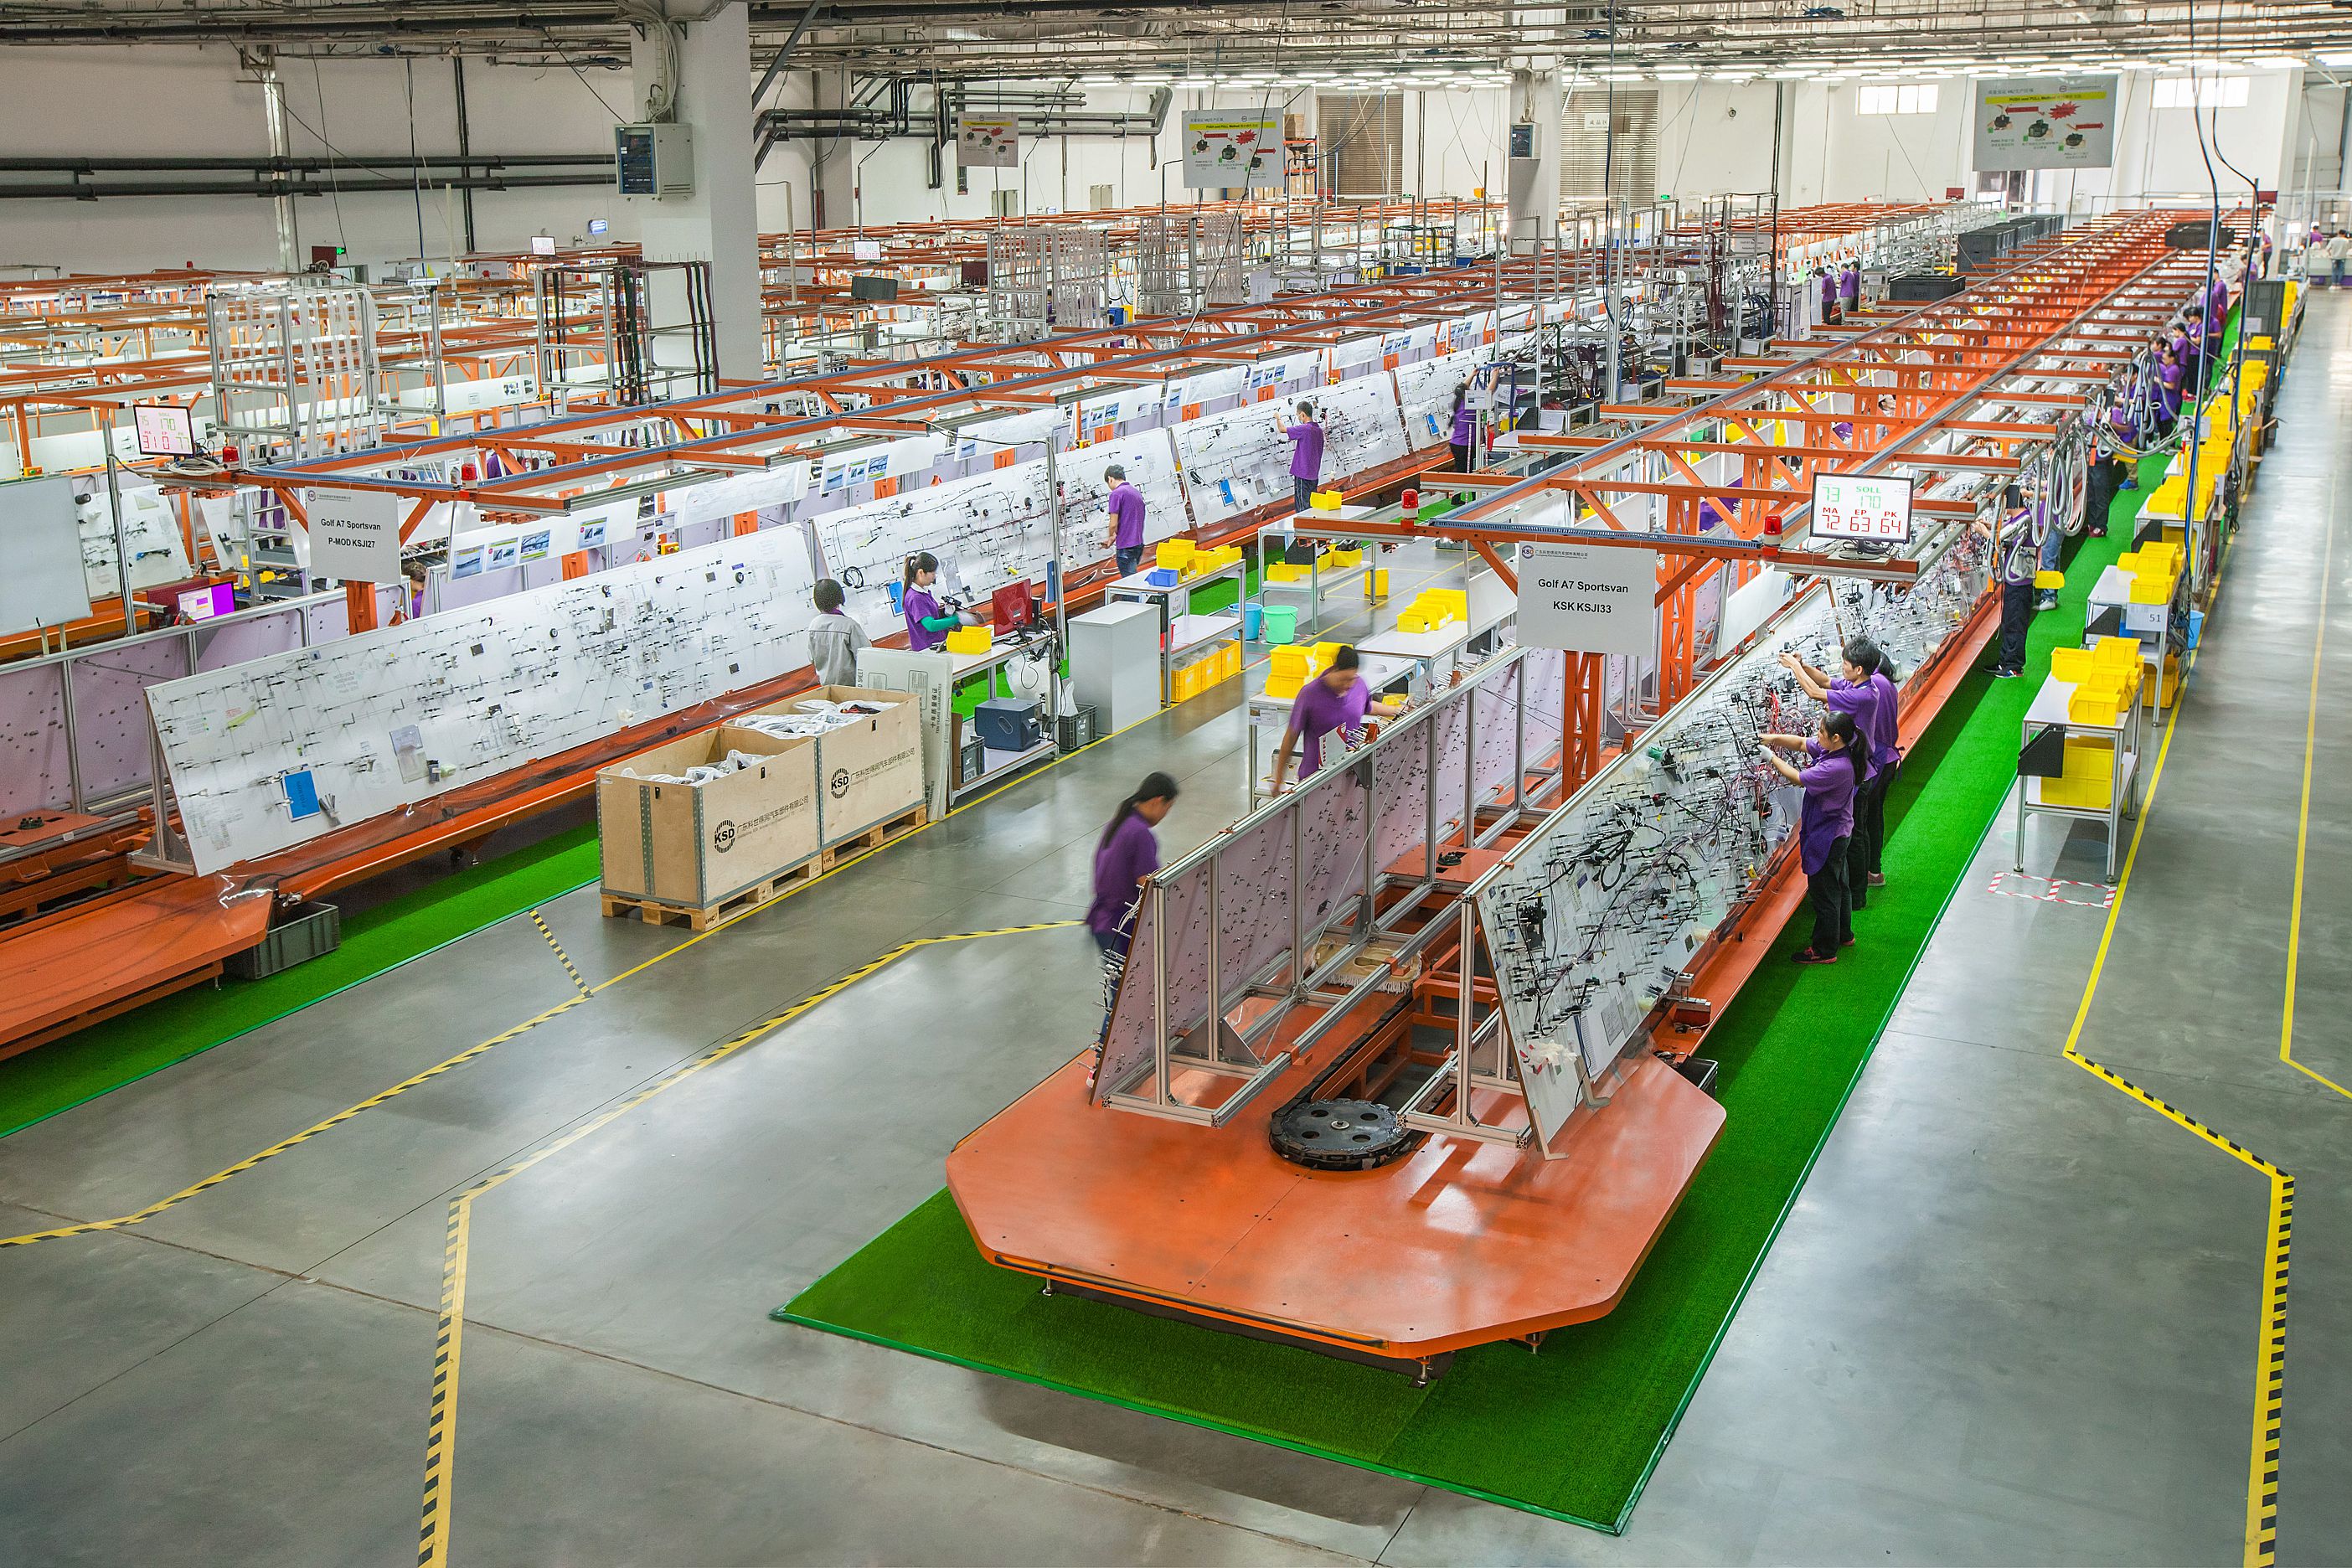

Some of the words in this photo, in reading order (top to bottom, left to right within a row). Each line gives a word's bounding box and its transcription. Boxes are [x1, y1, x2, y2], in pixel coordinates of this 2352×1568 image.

[1822, 487, 1840, 503] 73
[1860, 495, 1881, 509] 170
[321, 518, 334, 527] Golf
[336, 519, 345, 528] A7
[347, 520, 381, 531] Sportsvan
[1822, 514, 1840, 530] 72
[1849, 516, 1870, 532] 63
[1880, 518, 1901, 534] 64
[328, 537, 352, 546] P-MOD
[1538, 578, 1560, 589] Golf
[1561, 580, 1575, 590] A7
[1577, 581, 1628, 593] Sportsvan
[1553, 601, 1575, 611] KSK
[1576, 602, 1612, 614] KSJI33
[2149, 613, 2161, 622] 51
[831, 776, 849, 791] KSD
[714, 828, 735, 844] KSD
